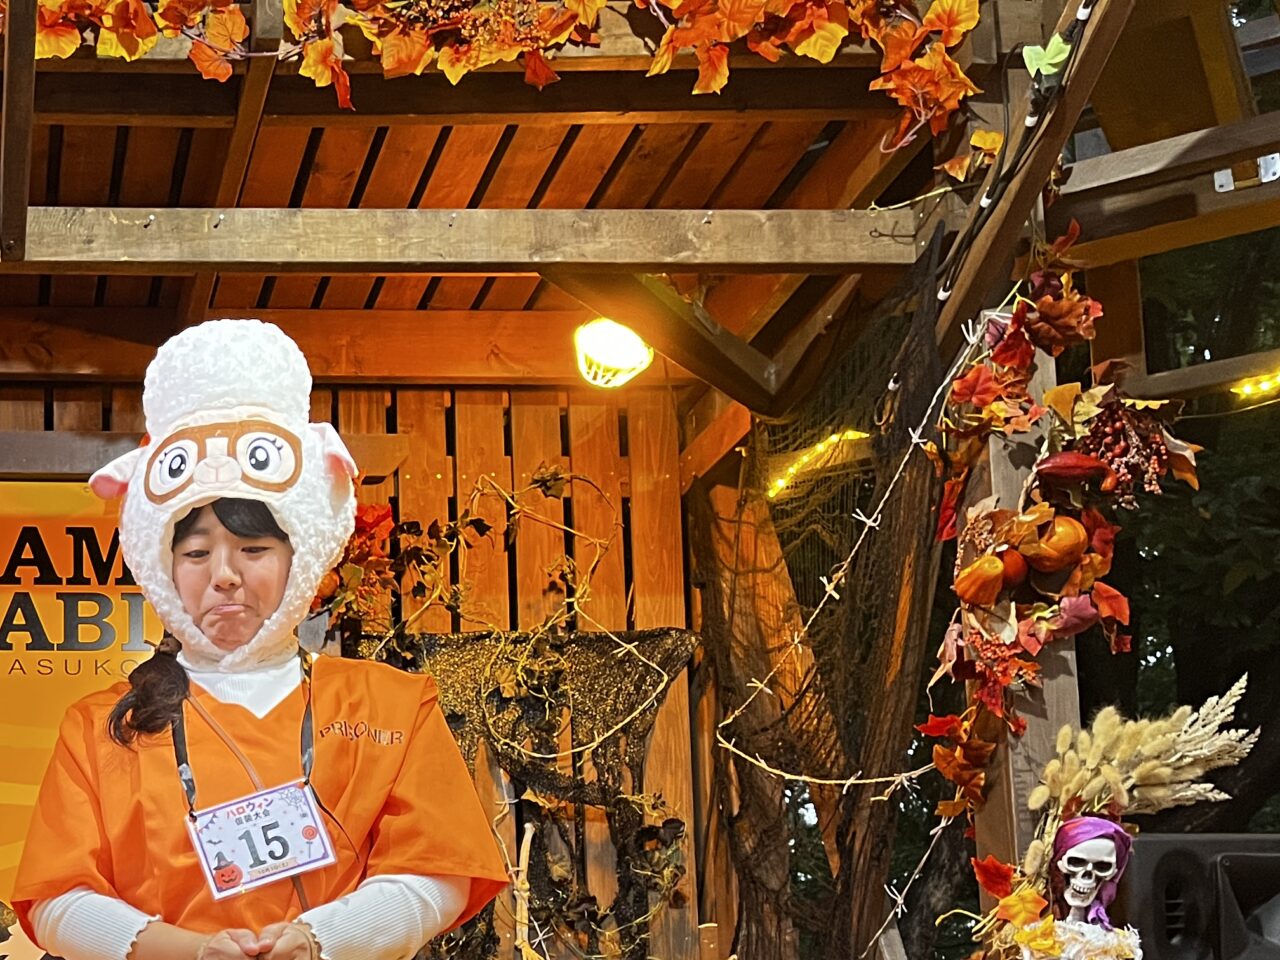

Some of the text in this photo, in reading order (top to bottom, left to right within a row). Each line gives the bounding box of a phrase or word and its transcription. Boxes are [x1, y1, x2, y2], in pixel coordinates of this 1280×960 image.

[319, 720, 404, 745] PRISONER
[226, 797, 274, 819] ハロウィン
[234, 809, 271, 827] 仮装大会
[238, 820, 290, 869] 15
